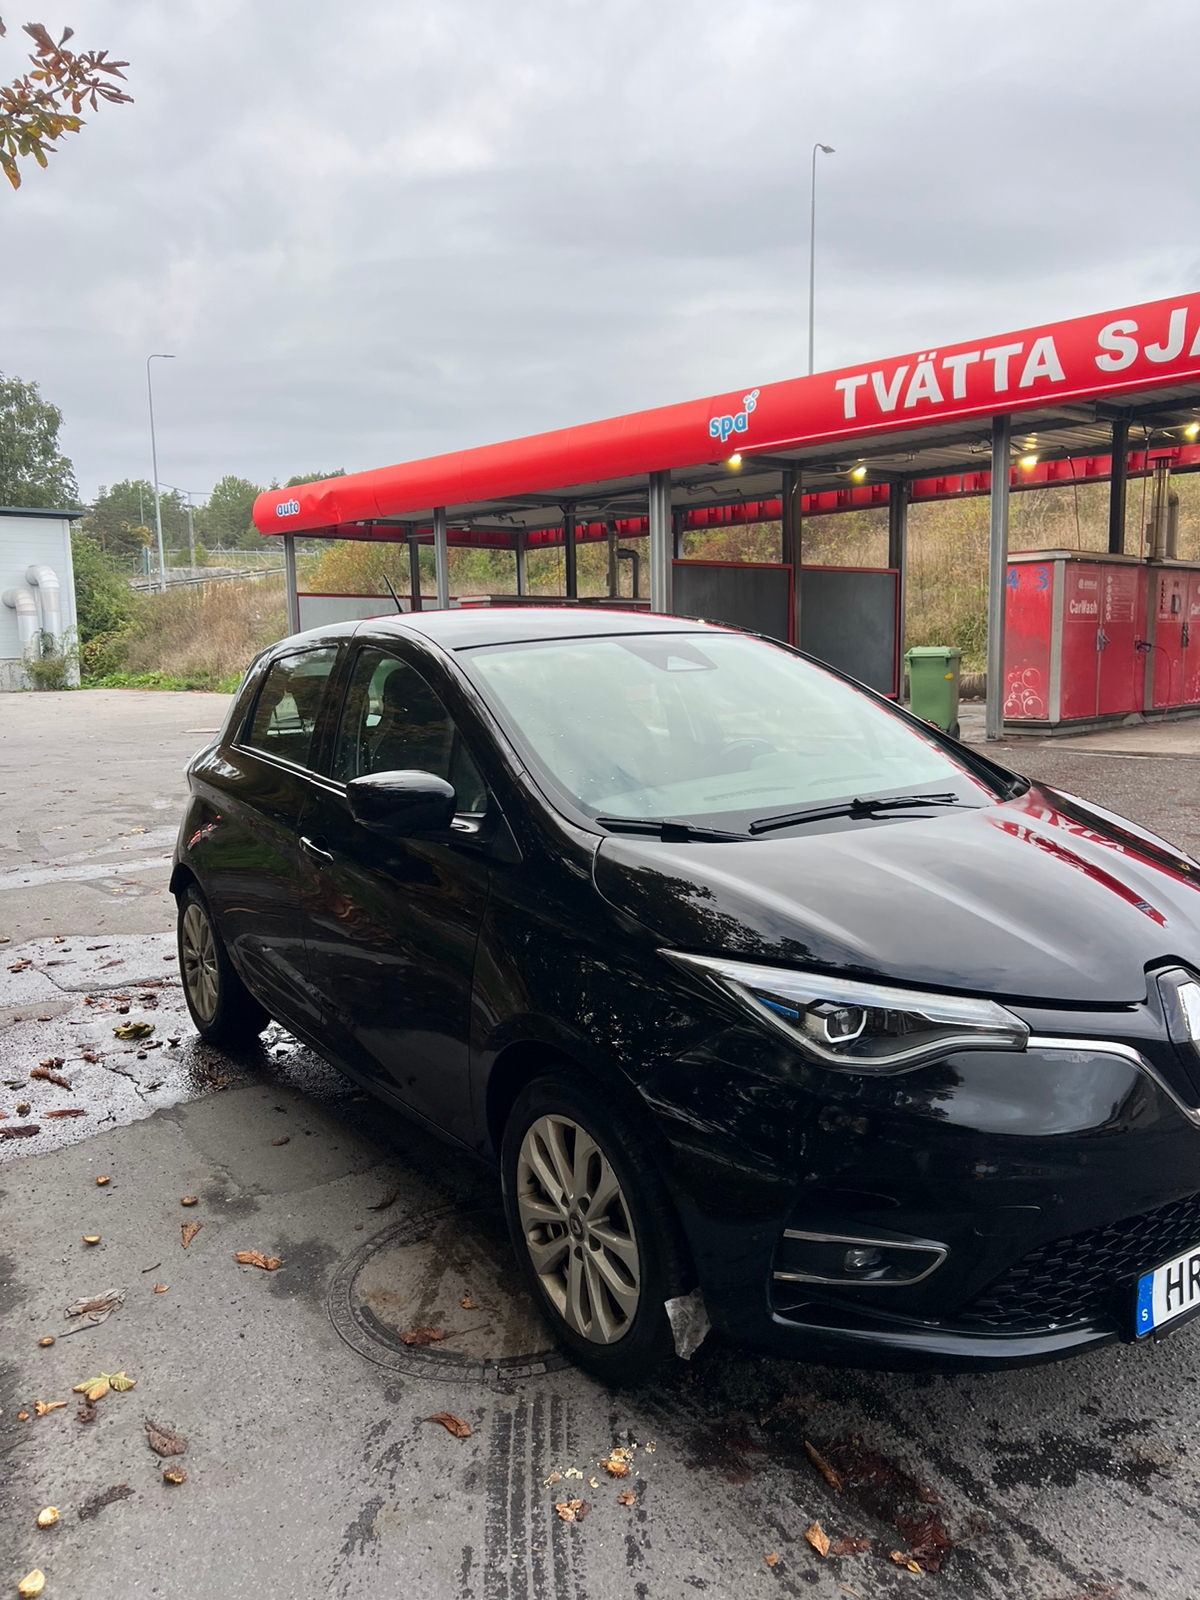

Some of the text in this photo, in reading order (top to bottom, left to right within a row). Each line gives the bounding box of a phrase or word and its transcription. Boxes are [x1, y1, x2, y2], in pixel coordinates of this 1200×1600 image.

[835, 307, 1200, 419] TVÄTTA SJ
[709, 412, 748, 442] spa
[276, 498, 300, 517] auto
[1006, 566, 1049, 590] 4 3
[1070, 599, 1098, 614] CarWash
[1141, 1308, 1149, 1321] S
